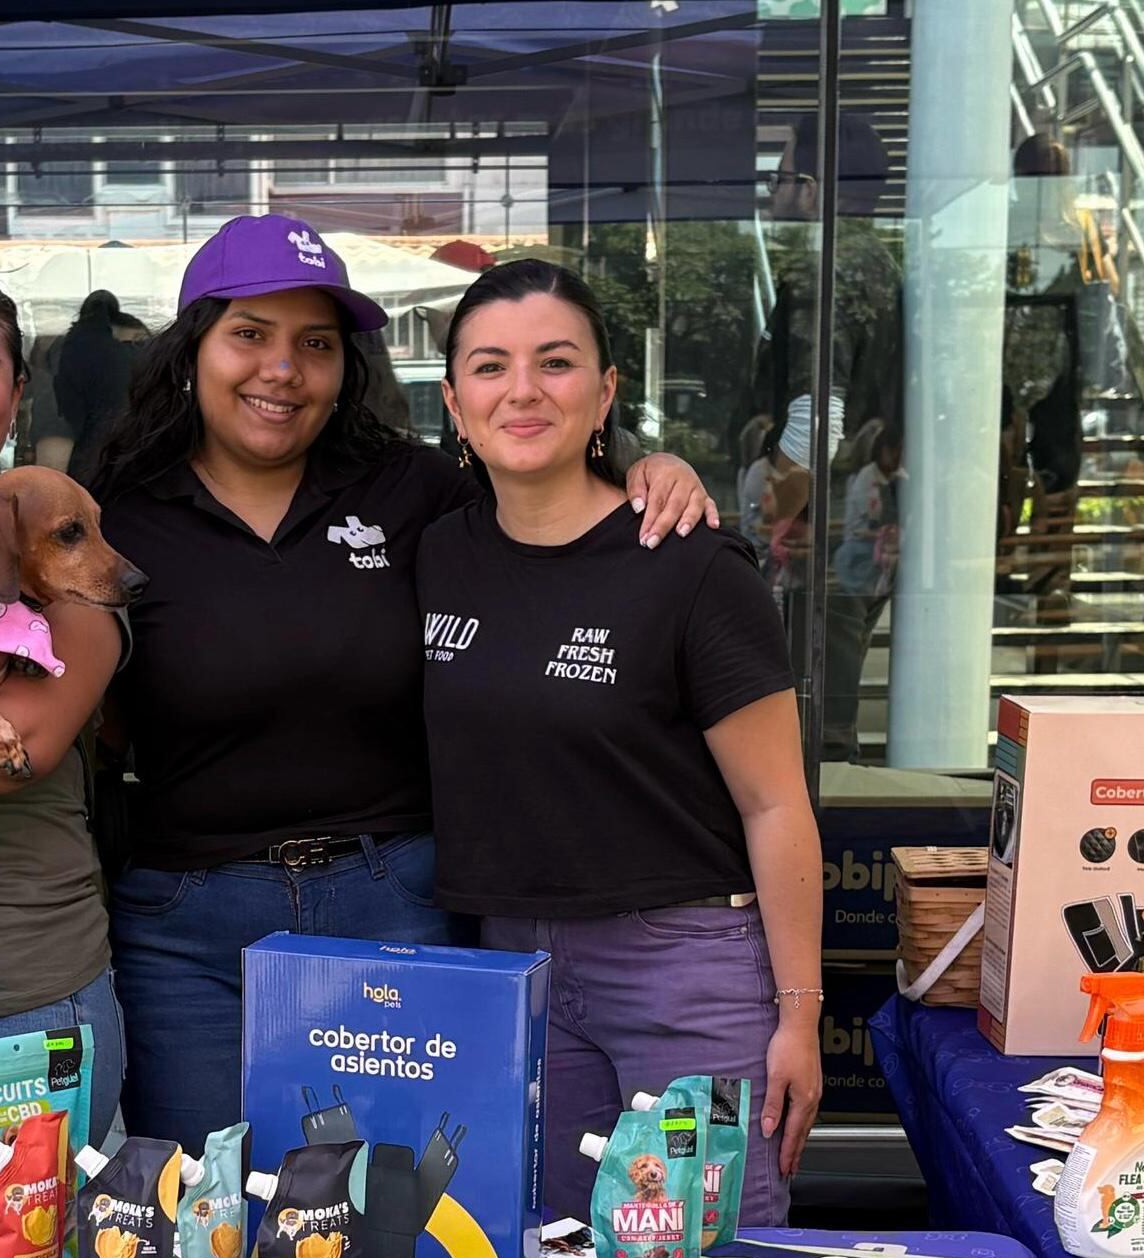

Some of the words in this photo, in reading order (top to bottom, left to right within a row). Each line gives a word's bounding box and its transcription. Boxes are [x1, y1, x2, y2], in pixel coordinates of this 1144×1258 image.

[298, 252, 326, 269] tobi
[348, 548, 390, 569] tobi
[424, 612, 479, 650] WILD
[571, 627, 610, 644] RAW
[557, 644, 615, 664] FRESH
[544, 661, 617, 685] FROZEN
[1095, 785, 1144, 799] Cober
[835, 909, 885, 924] Donde
[309, 1025, 416, 1055] cobertor
[425, 1033, 457, 1059] de
[330, 1051, 434, 1080] asientos
[8, 1101, 43, 1122] CBD
[1118, 1174, 1142, 1185] FLEA
[110, 1199, 155, 1218] MOKA'S
[298, 1201, 350, 1221] MOKA'S
[613, 1201, 684, 1232] MANÍ
[108, 1212, 154, 1228] TREATS
[301, 1214, 350, 1231] TREATS
